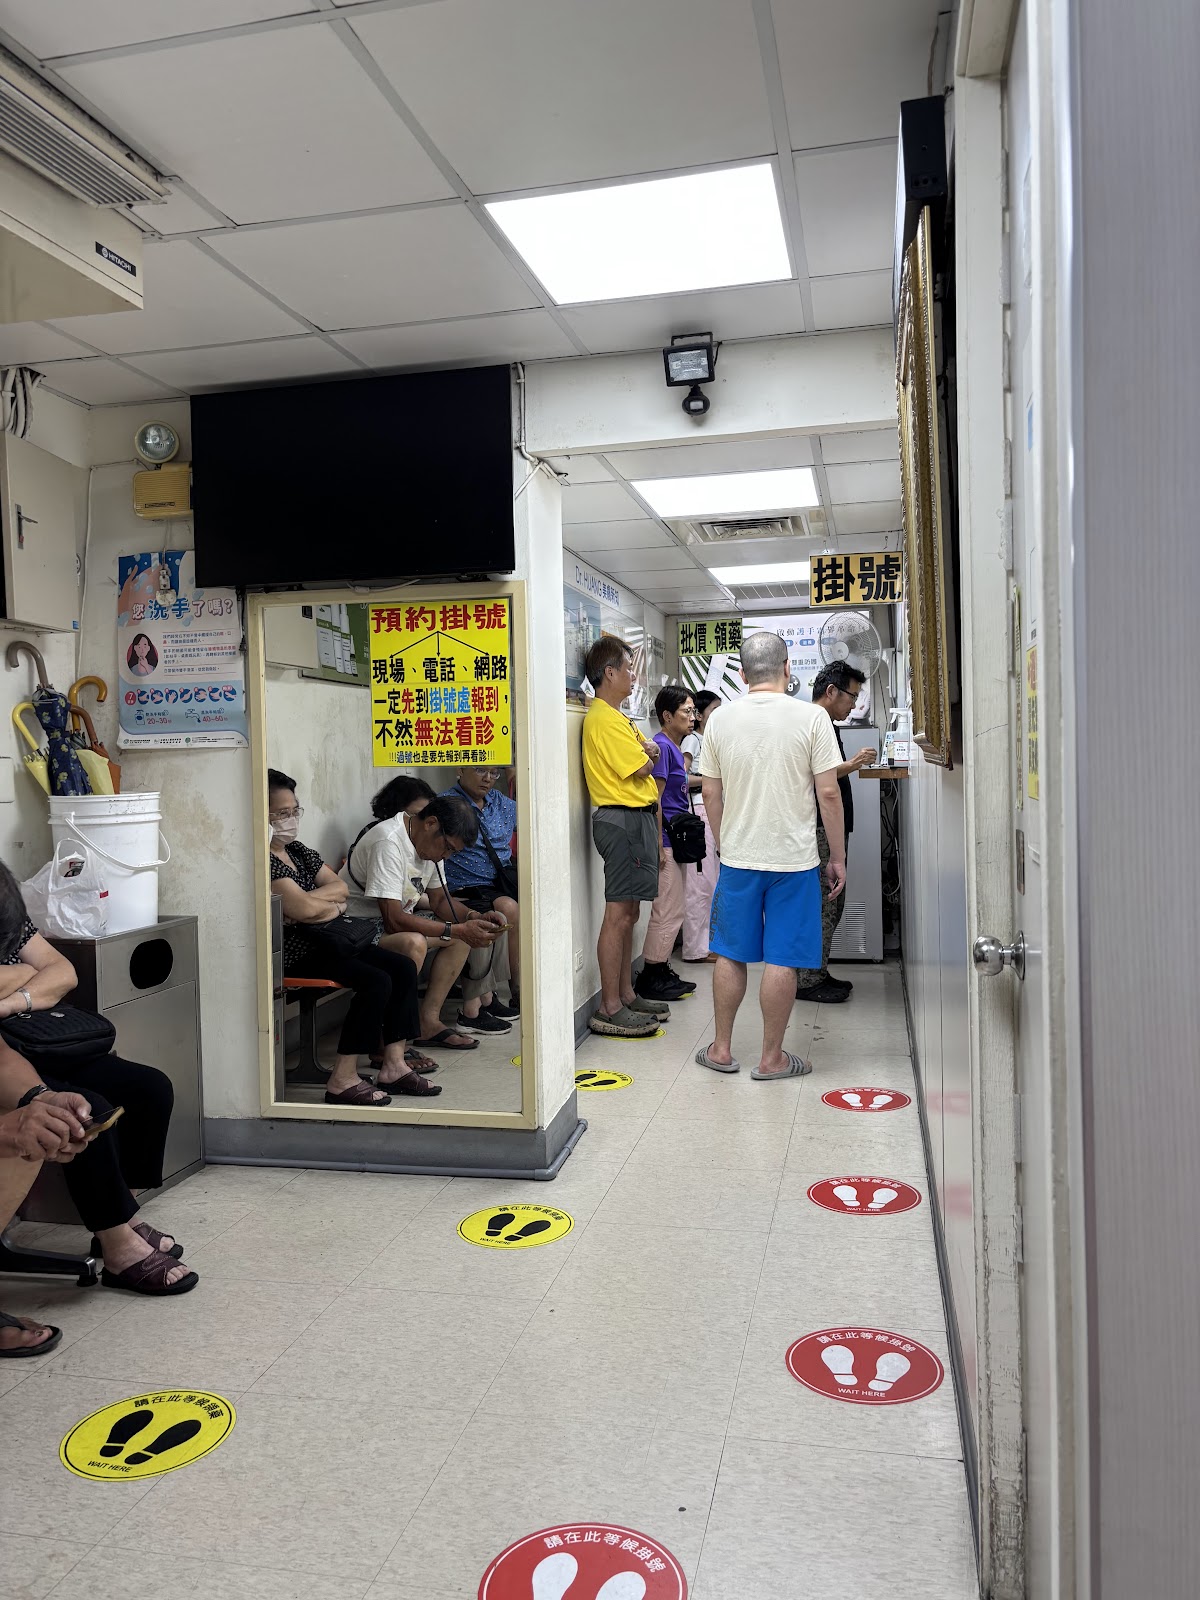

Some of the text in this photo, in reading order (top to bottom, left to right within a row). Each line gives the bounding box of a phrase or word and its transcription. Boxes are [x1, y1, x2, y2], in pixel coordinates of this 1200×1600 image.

[108, 252, 132, 271] HITACHI
[813, 555, 901, 603] 掛號
[132, 598, 233, 621] 您洗手了嗎?
[371, 603, 506, 633] 預約掛號
[372, 655, 507, 683] 現場、電話、網路
[374, 686, 508, 714] 一定先到掛號處報到，
[375, 716, 508, 747] 不然無法看診。
[816, 1331, 916, 1353] 請在此等候掛號
[134, 1394, 224, 1420] 請在此等候領藥
[87, 1460, 133, 1472] WAIT HERE
[543, 1530, 666, 1573] 請在此等候掛號
